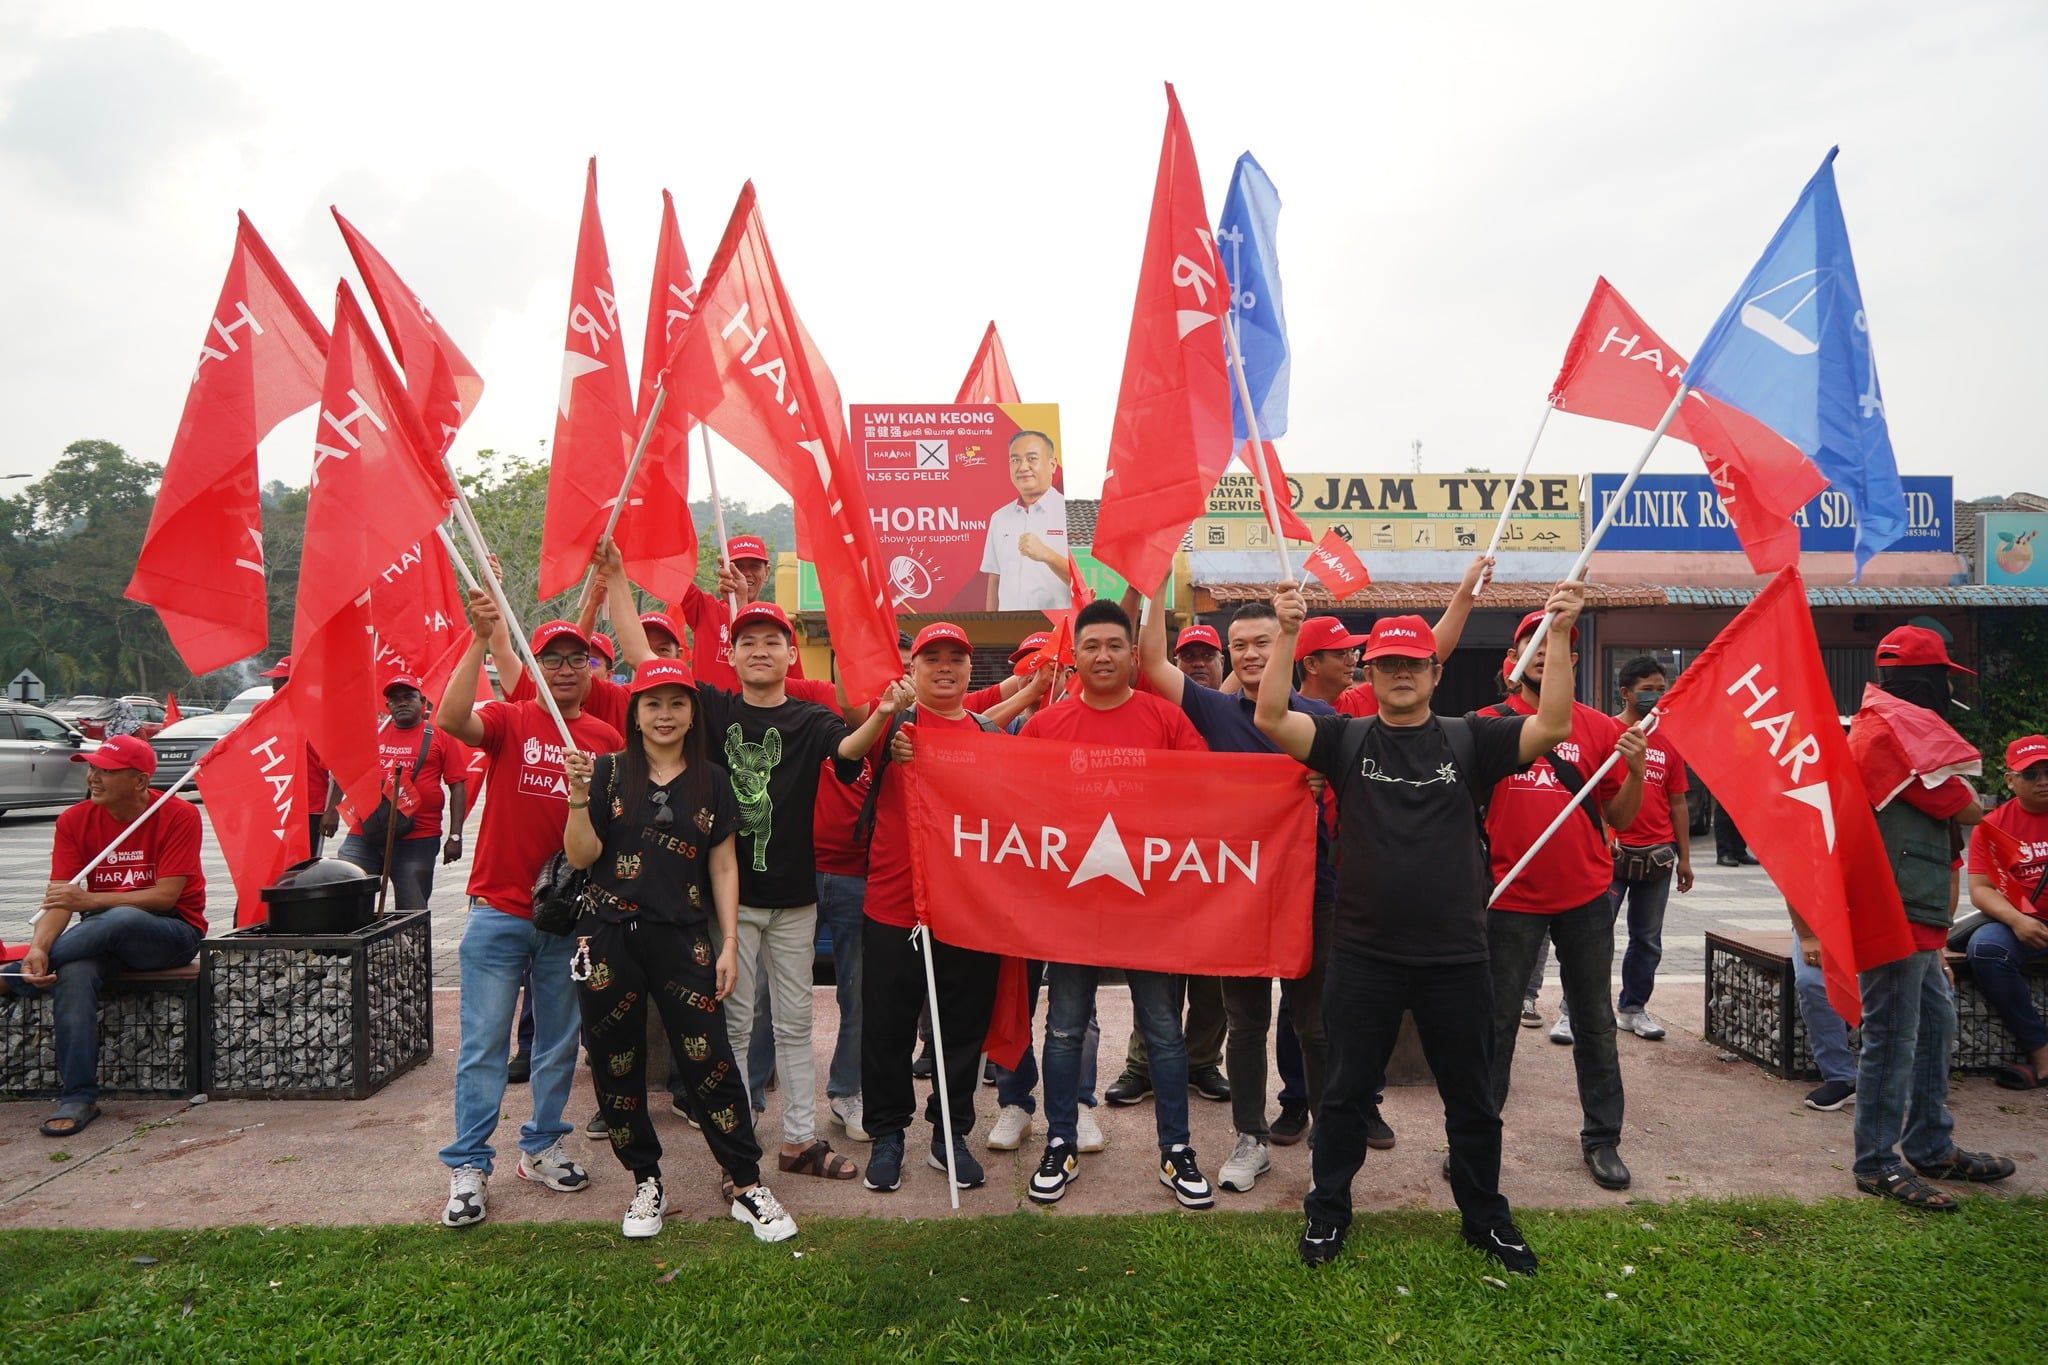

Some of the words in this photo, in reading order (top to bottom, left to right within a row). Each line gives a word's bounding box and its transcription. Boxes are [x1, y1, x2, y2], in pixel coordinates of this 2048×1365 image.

[865, 413, 894, 424] LWI
[899, 413, 936, 424] KIAN
[941, 413, 994, 424] KEONG
[874, 450, 911, 459] HARAPAN
[866, 472, 892, 481] N.56
[895, 472, 910, 481] SG
[913, 472, 950, 481] PELEK
[1219, 476, 1255, 486] USAT
[1314, 478, 1417, 510] JAM
[1440, 479, 1568, 510] TYRE
[1210, 501, 1261, 511] SERVIS
[1903, 491, 1941, 529] HD.
[880, 534, 904, 544] show
[906, 535, 928, 545] your
[929, 533, 970, 544] support!!
[1315, 546, 1354, 583] HARAPAN
[544, 625, 577, 636] HARAPAN
[1379, 628, 1417, 639] HARAPAN
[647, 666, 682, 678] HARAPAN
[1090, 747, 1145, 757] MALAYSIA
[1091, 756, 1146, 769] MADANI
[1074, 778, 1144, 798] HARAPAN
[952, 811, 1260, 897] HARAPAN
[95, 868, 152, 886] HARAPAN
